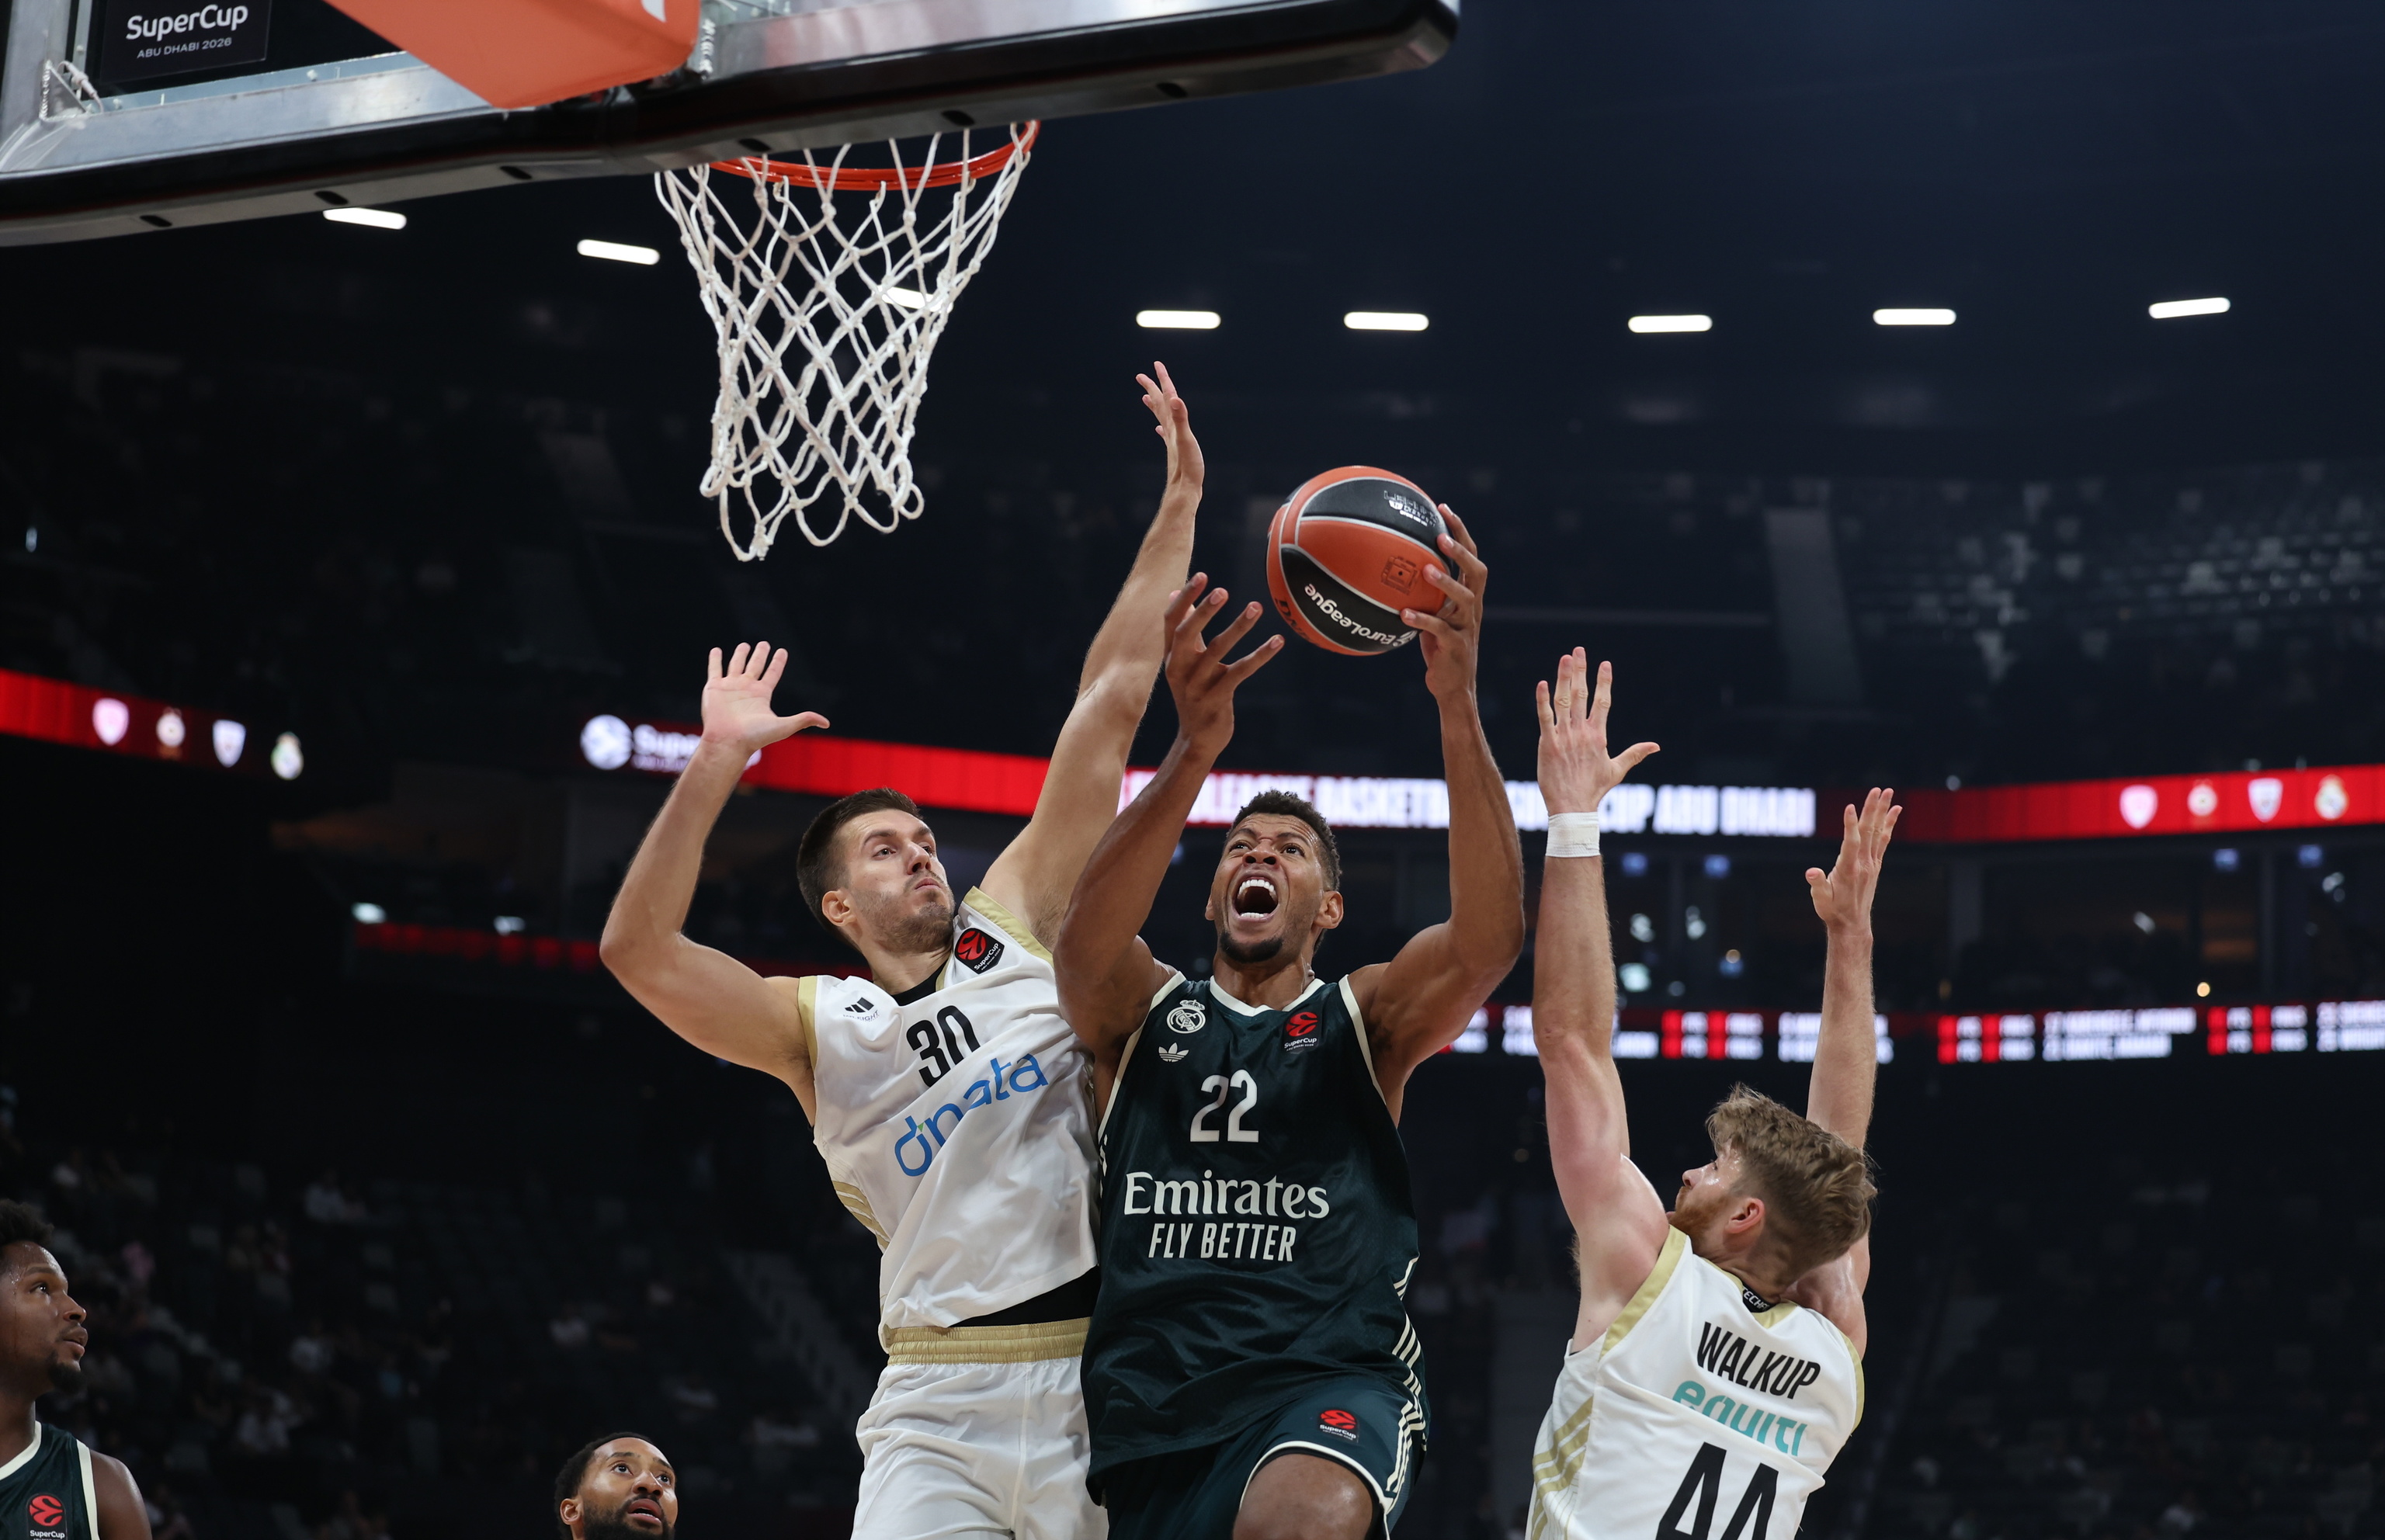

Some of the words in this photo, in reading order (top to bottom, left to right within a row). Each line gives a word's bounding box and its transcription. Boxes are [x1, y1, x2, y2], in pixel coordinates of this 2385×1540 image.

[126, 4, 248, 41] SuperCup
[137, 45, 161, 59] ABU
[163, 41, 200, 55] DHABI
[202, 37, 232, 50] 2026
[1304, 584, 1396, 644] EuroLeague
[974, 942, 999, 970] SuperCup
[906, 1005, 981, 1087] 30
[1283, 1037, 1317, 1049] SuperCup
[894, 1053, 1048, 1177] dnata
[1190, 1069, 1258, 1143] 22
[1124, 1170, 1329, 1219] Emirates
[1148, 1223, 1194, 1259] FLY
[1200, 1223, 1297, 1262] BETTER
[1696, 1322, 1821, 1400] WALKUP
[1320, 1424, 1356, 1439] SuperCup
[1655, 1441, 1779, 1540] 44
[30, 1529, 65, 1539] SuperCup
